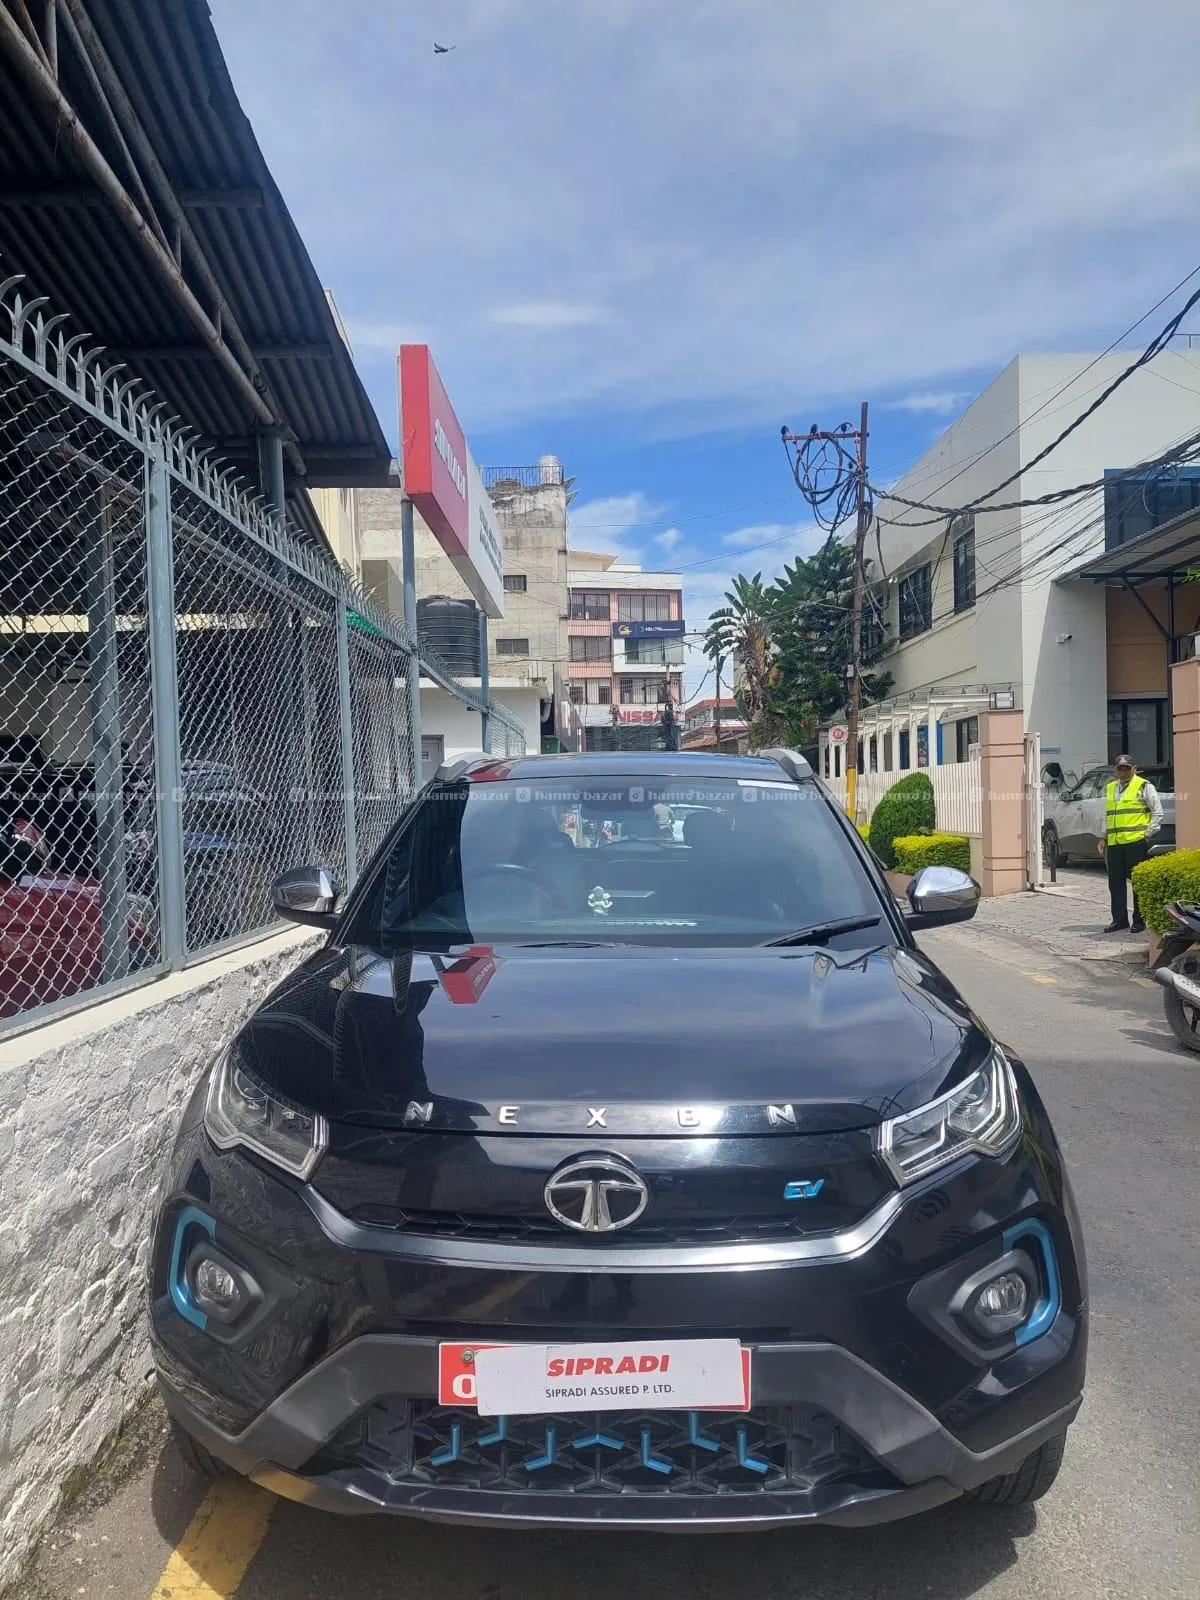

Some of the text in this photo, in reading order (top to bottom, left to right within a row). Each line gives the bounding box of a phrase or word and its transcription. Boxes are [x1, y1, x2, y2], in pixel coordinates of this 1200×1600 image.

[547, 1354, 670, 1377] SIPRADI
[545, 1384, 675, 1399] SIPRADI ASSURED P. LTD.
